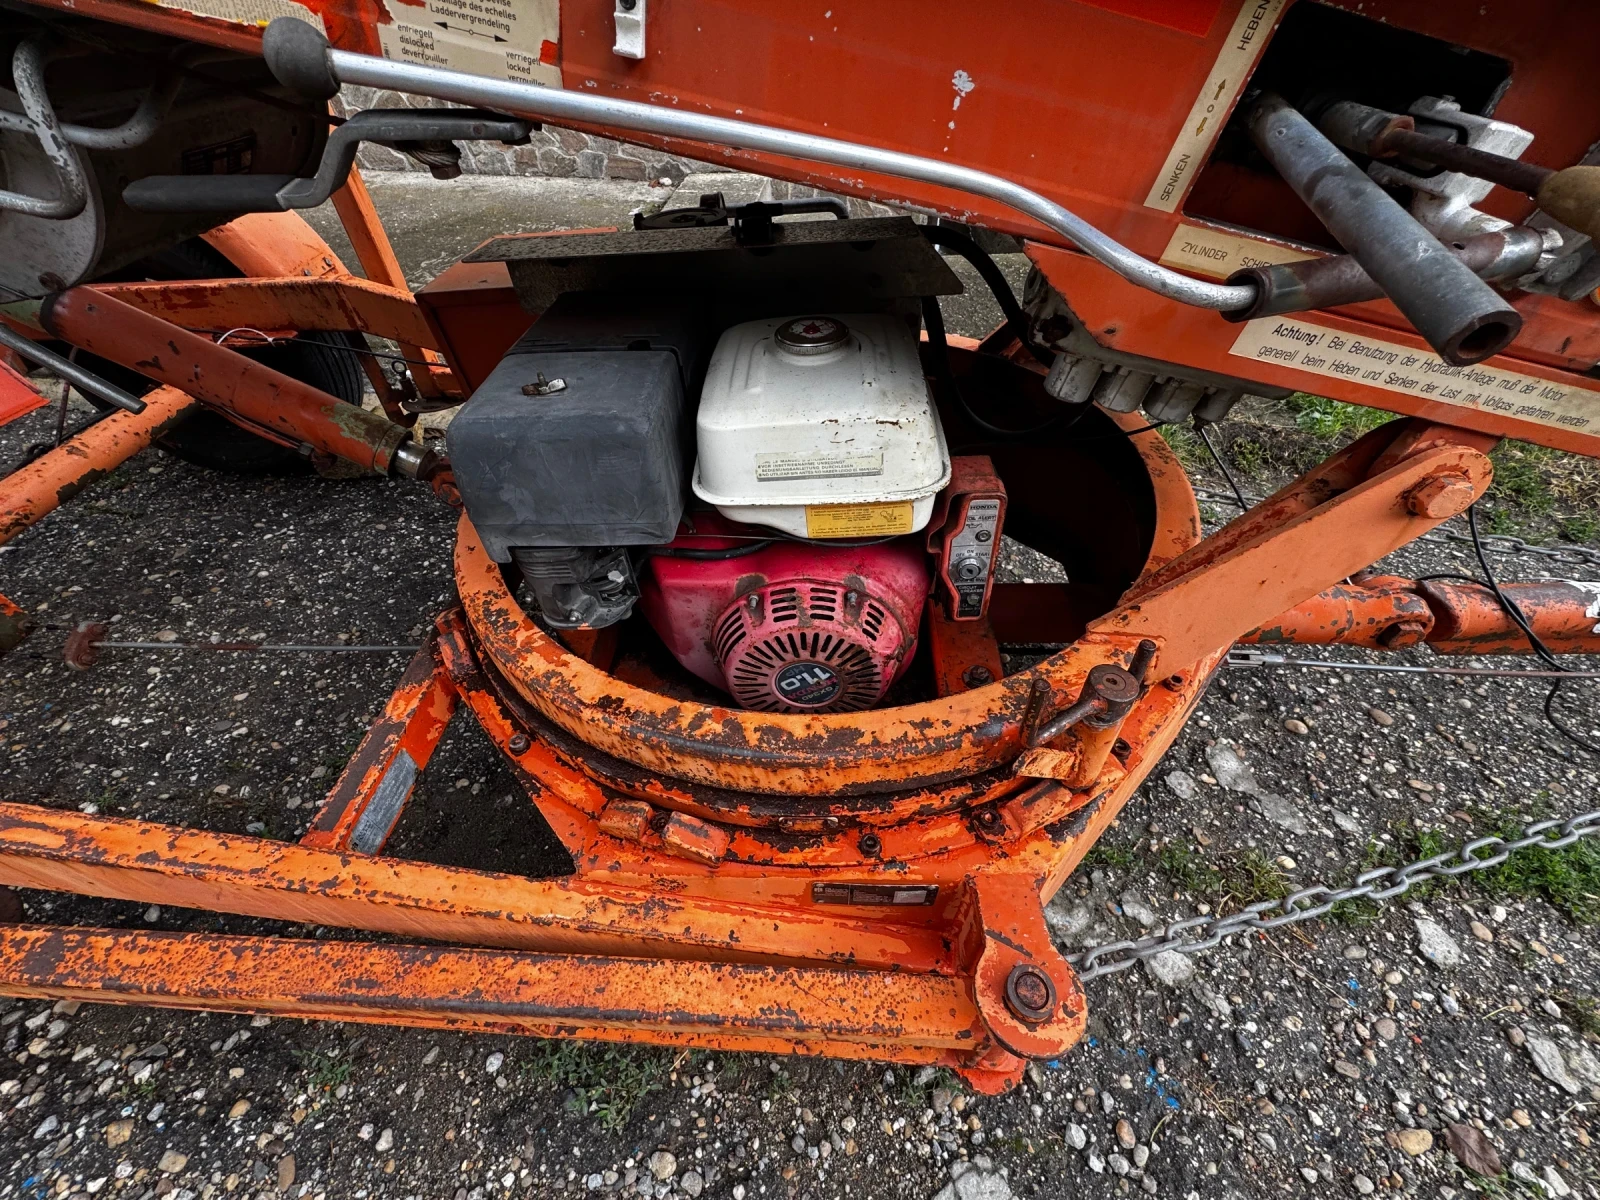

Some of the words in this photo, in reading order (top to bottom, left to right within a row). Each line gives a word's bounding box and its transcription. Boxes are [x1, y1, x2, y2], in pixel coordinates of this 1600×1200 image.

[430, 3, 510, 34] Laddervergrendeling
[469, 2, 483, 13] des
[484, 6, 517, 21] echelles
[397, 23, 433, 39] entriegelt
[1236, 0, 1270, 51] HEBEN
[399, 35, 435, 51] dislocked
[401, 47, 448, 66] deverrouiller
[506, 61, 531, 75] locked
[1160, 153, 1191, 202] SENKEN
[1180, 242, 1228, 262] ZYLINDER
[1327, 336, 1347, 350] Bei
[1348, 340, 1399, 365] Benutzung
[1400, 354, 1420, 367] der
[1498, 379, 1522, 392] muß
[1519, 382, 1539, 395] der
[1537, 386, 1568, 402] Motor
[1257, 344, 1299, 362] generell
[1301, 353, 1326, 369] beim
[1328, 359, 1360, 377] Heben
[1362, 368, 1384, 381] und
[1384, 372, 1419, 389] Senken
[1420, 380, 1439, 394] der
[1439, 386, 1463, 400] Last
[1463, 392, 1481, 404] mit
[1482, 394, 1514, 412] Vollgas
[1515, 404, 1555, 421] gefahren
[1556, 413, 1590, 428] werden
[780, 667, 831, 691] 11.0
